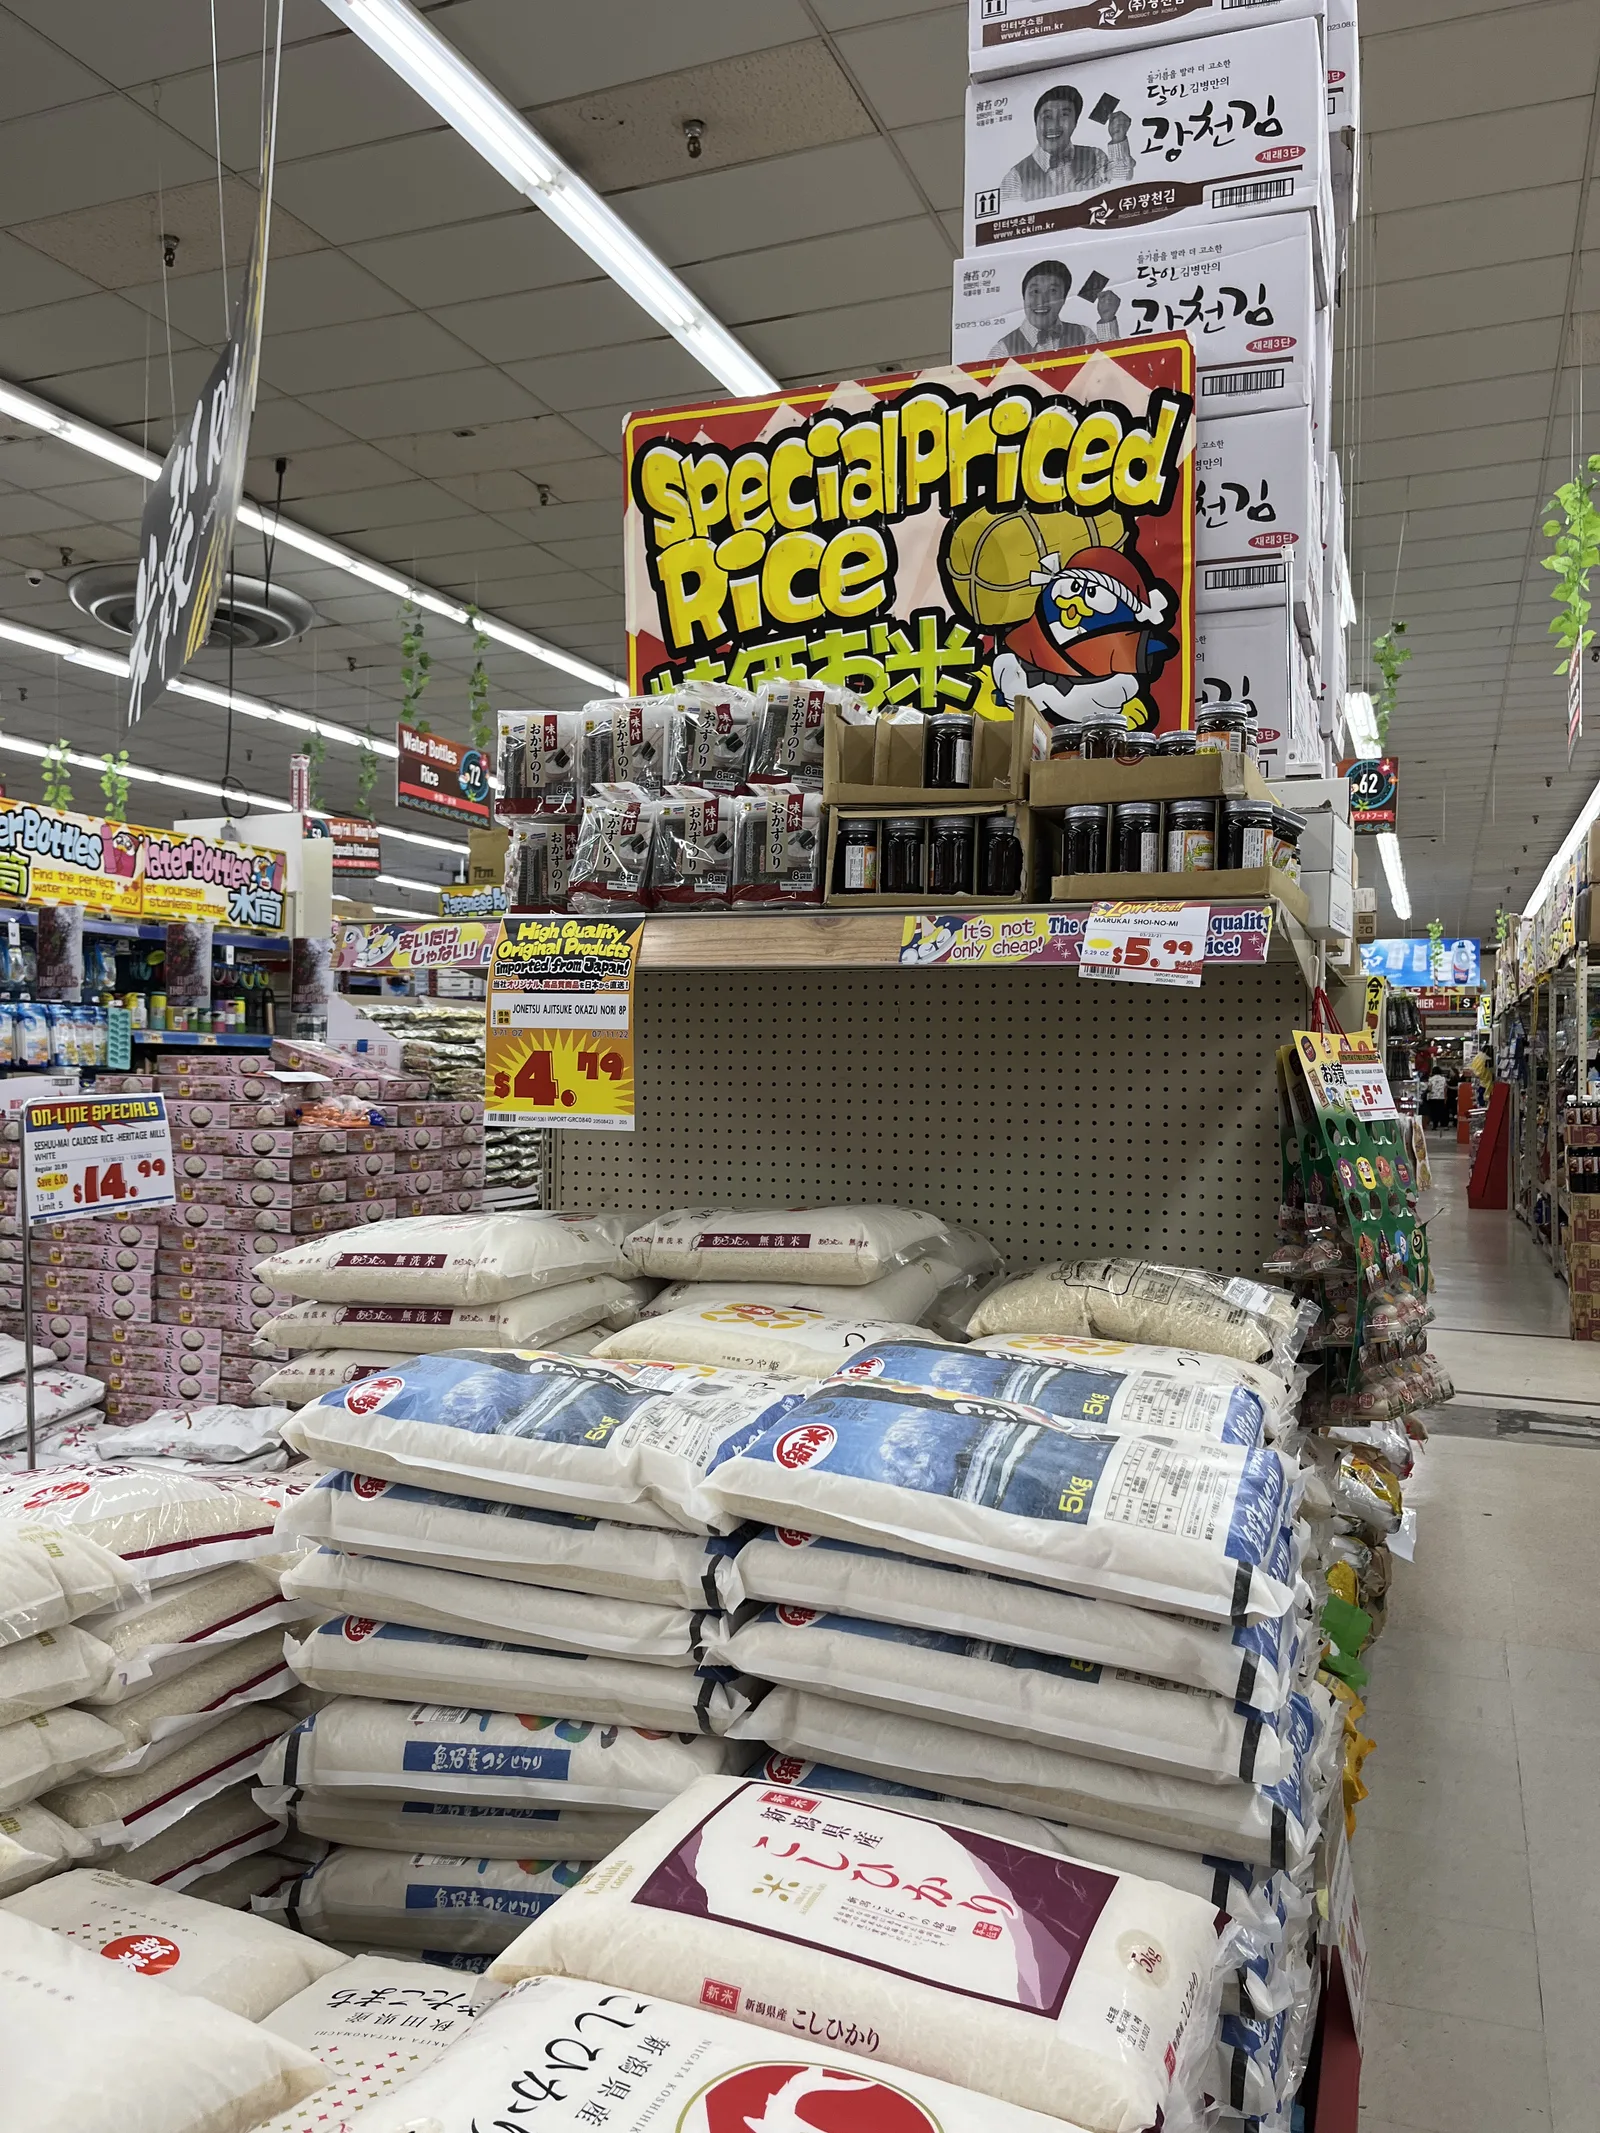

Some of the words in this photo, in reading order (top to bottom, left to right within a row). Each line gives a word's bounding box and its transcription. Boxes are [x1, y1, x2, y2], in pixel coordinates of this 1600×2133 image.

[1000, 16, 1045, 31] 인터넷쇼핑
[1000, 23, 1064, 41] www.kckim.kr
[1208, 59, 1231, 69] 고소한
[994, 97, 1008, 107] のり
[1147, 84, 1189, 106] 달인
[1190, 76, 1229, 93] 김병만의
[1140, 95, 1283, 162] 광천김
[1261, 147, 1299, 160] 재래3단
[1118, 189, 1176, 212] (주)광천김
[993, 215, 1036, 231] 인터넷쇼핑
[993, 222, 1055, 240] www.kckim.kr
[1199, 244, 1223, 254] 고소한
[982, 268, 996, 278] のり
[1137, 266, 1179, 288] 달인
[1180, 262, 1221, 278] 김병만의
[1252, 337, 1291, 350] 재래3단
[642, 408, 899, 549] Special
[1253, 534, 1295, 547] 재래3단
[656, 526, 888, 650] Rice
[717, 711, 732, 733] 味付
[807, 699, 821, 725] 味付
[545, 723, 557, 749] 味付
[630, 715, 641, 741] 味付
[786, 694, 805, 762] おかずのり
[402, 730, 428, 755] Water
[428, 739, 457, 765] Bottles
[529, 722, 542, 785] おかずのり
[616, 718, 628, 781] おかずのり
[421, 764, 439, 786] Rice
[469, 764, 481, 787] 72
[1358, 772, 1379, 796] 62
[704, 806, 716, 831] 味付
[787, 803, 801, 827] 味付
[689, 806, 701, 872] おかずのり
[770, 802, 784, 870] おかずのり
[551, 831, 562, 893] おかずのり
[33, 868, 53, 881] Find
[58, 872, 74, 882] the
[78, 873, 116, 890] perfect
[33, 883, 62, 894] water
[68, 886, 97, 899] bottle
[101, 890, 116, 904] for
[120, 895, 138, 908] you!
[164, 885, 203, 899] yourself
[149, 898, 193, 911] stainless
[196, 901, 226, 916] bottle!
[228, 885, 284, 929] 水筒
[442, 893, 493, 914] Japanese
[1106, 902, 1144, 917] Low
[1145, 902, 1185, 913] Price!!
[518, 922, 559, 941] High
[562, 920, 626, 943] Quality
[963, 922, 992, 941] It's
[1001, 919, 1034, 937] not
[1048, 917, 1078, 936] The
[399, 927, 458, 950] 安いだけ
[951, 941, 986, 960] only
[992, 936, 1043, 956] cheap!
[498, 941, 562, 960] Original
[564, 941, 632, 958] Products
[1112, 937, 1193, 968] $5.99
[496, 959, 549, 976] imported
[551, 957, 582, 973] from
[584, 957, 631, 976] Japan!
[512, 1004, 540, 1014] JONETSU
[543, 1004, 572, 1014] AJITSUKE
[575, 1004, 598, 1014] OKAZU
[600, 1005, 616, 1015] NORI
[619, 1006, 627, 1015] 8P
[493, 1050, 625, 1108] $4.79
[92, 1101, 159, 1121] SPECIALS
[34, 1138, 70, 1151] SESHUU-MAI
[72, 1135, 98, 1147] CALROSE
[100, 1133, 114, 1143] RICE
[116, 1130, 148, 1142] -HERITAGE
[149, 1128, 166, 1138] MILLS
[34, 1152, 56, 1161] WHITE
[35, 1165, 53, 1173] Regular
[54, 1163, 68, 1171] 20.99
[36, 1177, 52, 1188] Save
[54, 1174, 68, 1185] 6.00
[72, 1158, 166, 1204] $14.99
[38, 1203, 55, 1212] Limit
[59, 1201, 64, 1209] 5
[657, 1237, 684, 1245] 無洗米
[758, 1235, 800, 1246] 無洗米
[394, 1255, 436, 1267] 無洗米
[401, 1310, 442, 1323] 無洗米
[745, 1358, 779, 1371] つや姫
[1083, 1392, 1110, 1416] 5kg
[585, 1416, 621, 1443] 5kg
[1059, 1476, 1093, 1514] 5kg
[431, 1744, 543, 1772] 魚沼産コシヒカリ
[770, 1793, 808, 1809] 新米
[760, 1807, 884, 1849] 新潟県産
[752, 1836, 1016, 1917] こしひかり
[704, 1984, 738, 2005] 新米
[344, 2011, 456, 2033] 秋田県産
[744, 1997, 788, 2022] 新潟県産
[792, 2007, 880, 2053] こしひかり
[314, 2029, 411, 2047] AKITAKOMACHI
[418, 2037, 449, 2049] AKITA
[671, 2038, 713, 2080] NIIGATA
[573, 2034, 674, 2127] 新潟県産
